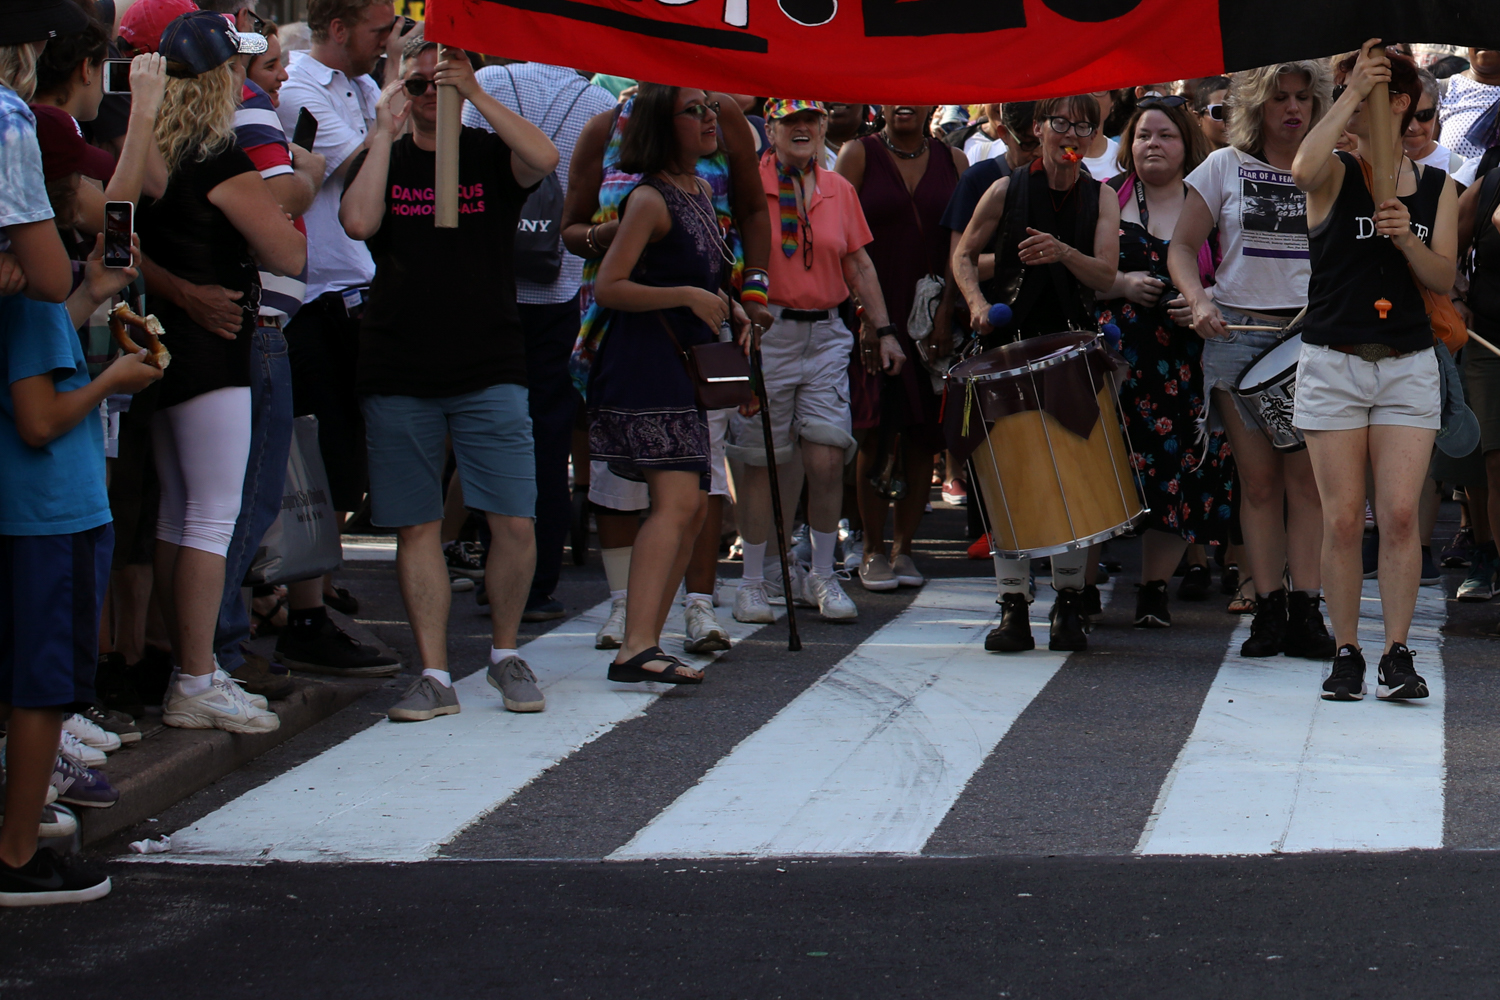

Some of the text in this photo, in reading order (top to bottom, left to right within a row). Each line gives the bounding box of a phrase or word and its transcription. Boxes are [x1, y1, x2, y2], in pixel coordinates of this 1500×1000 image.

[1240, 169, 1257, 179] FEAR
[1259, 172, 1269, 180] OF
[1355, 217, 1429, 243] DE
